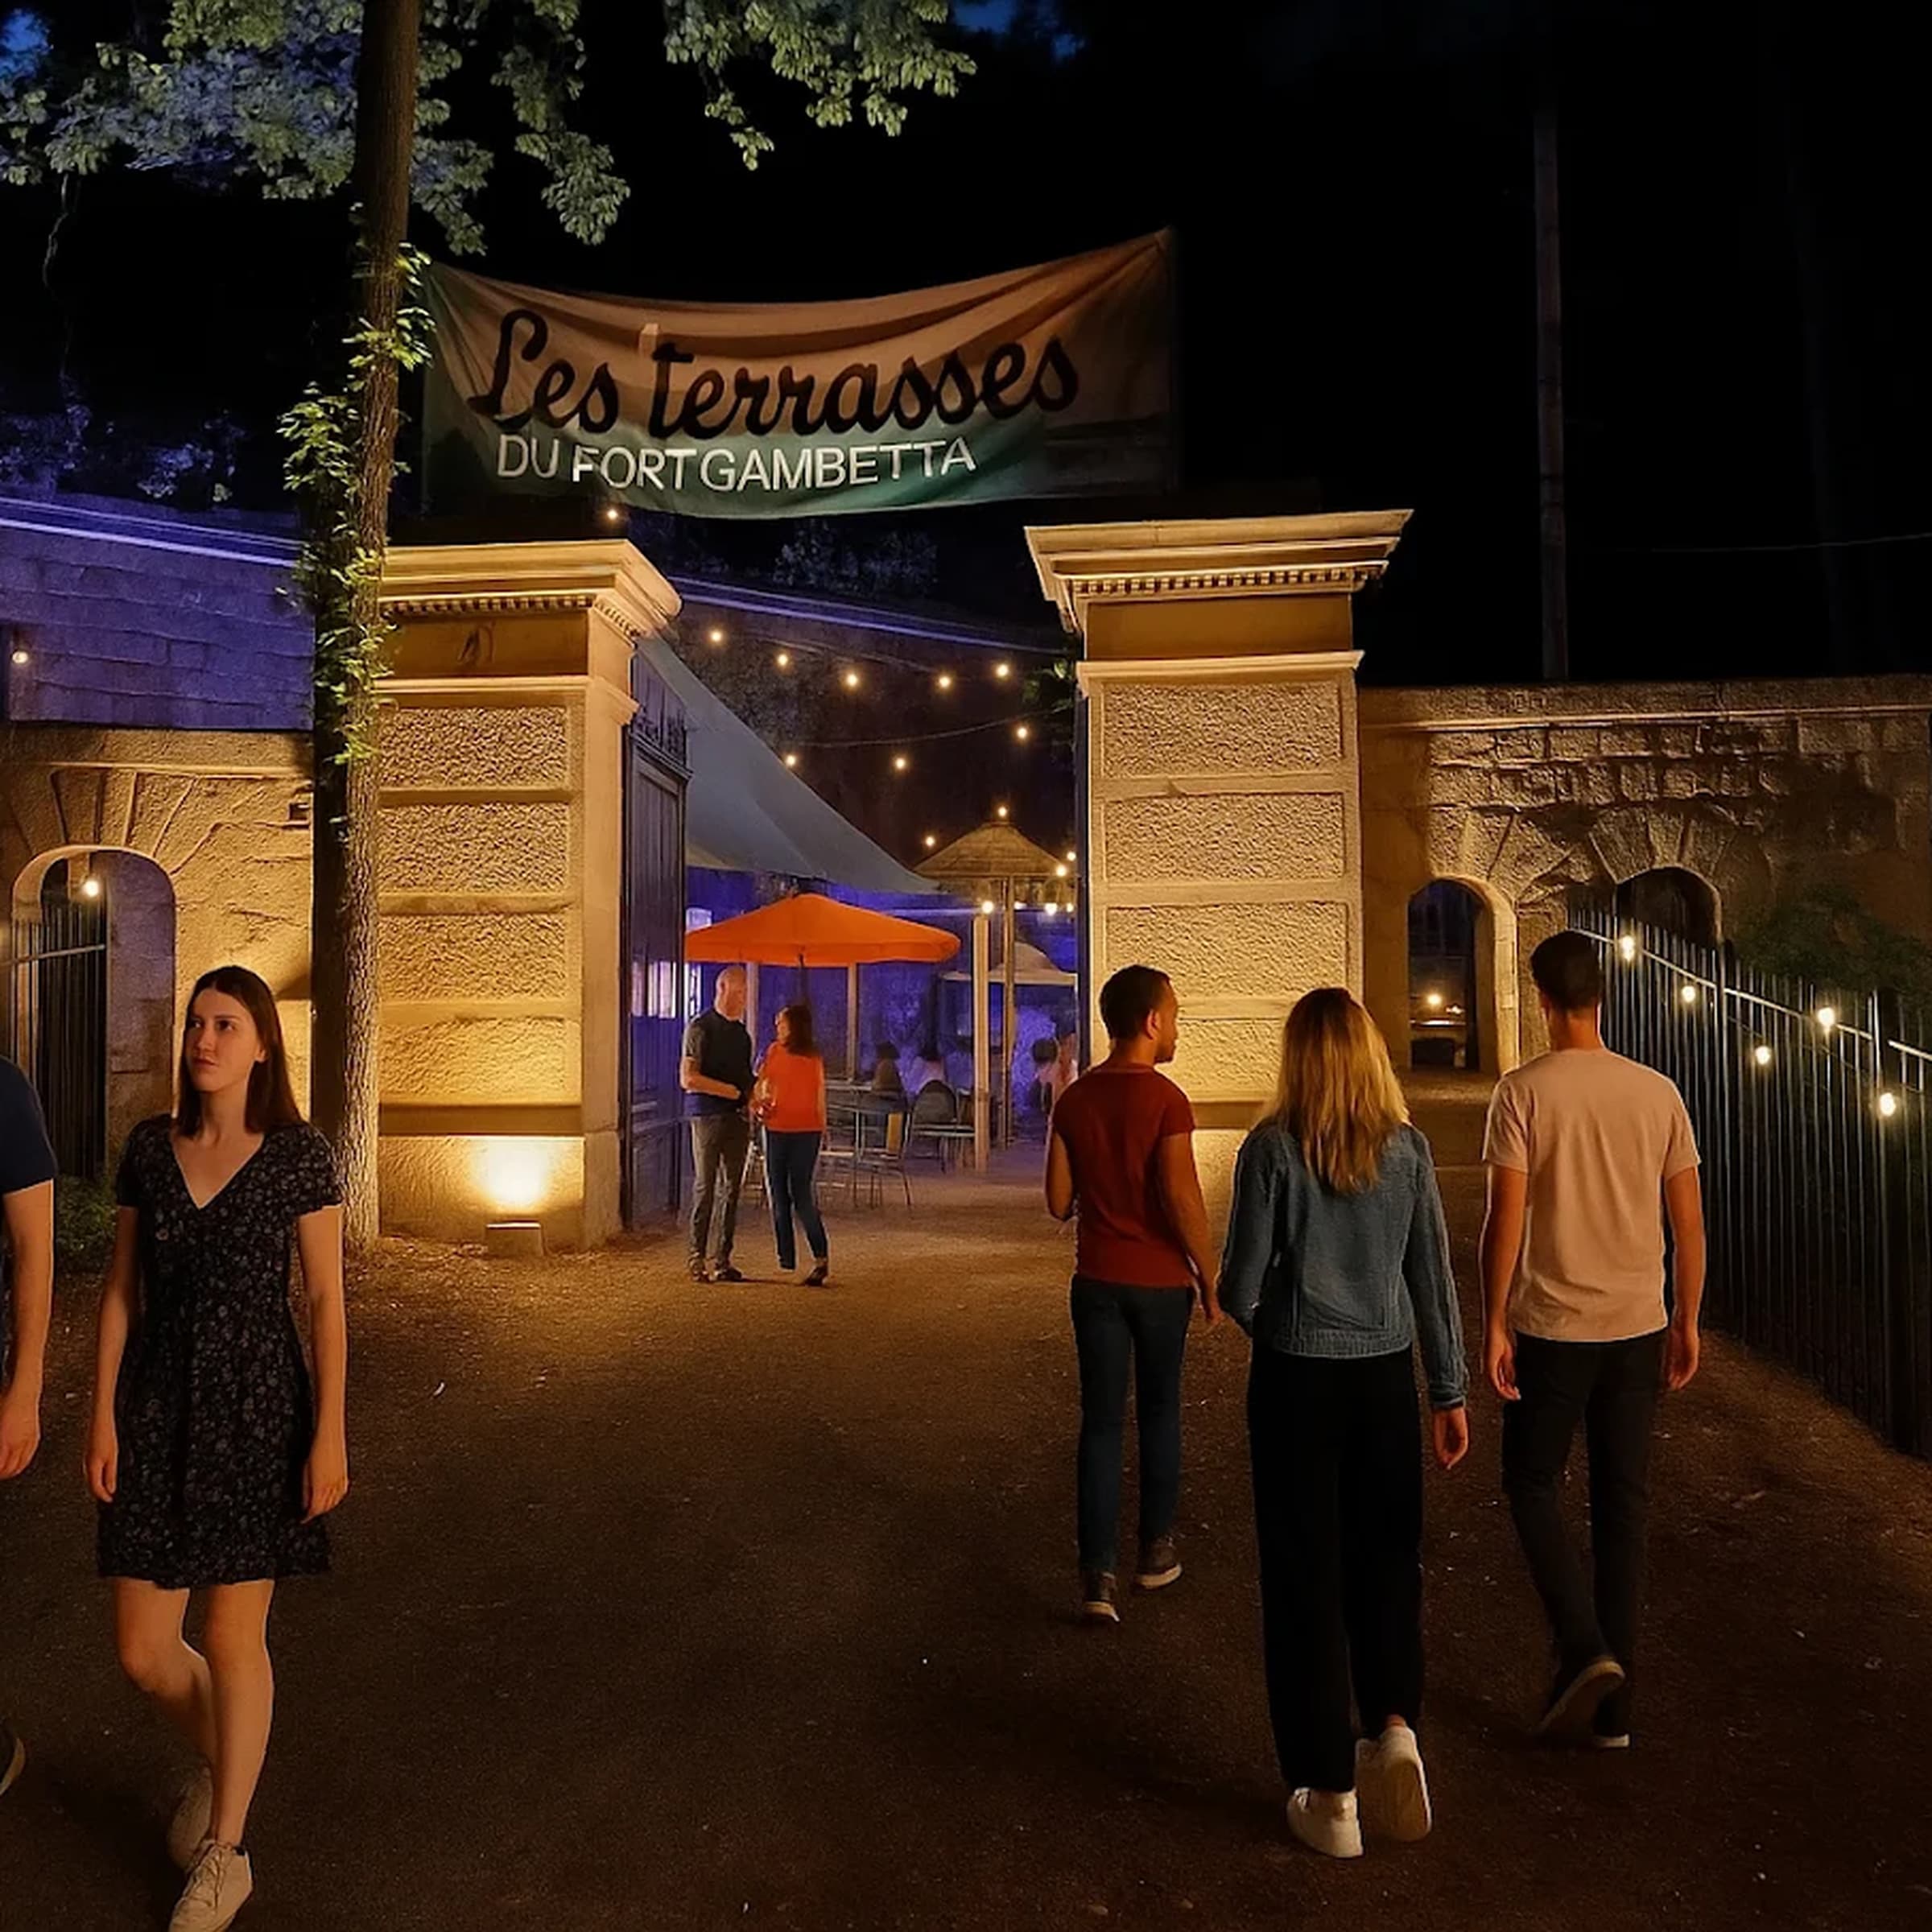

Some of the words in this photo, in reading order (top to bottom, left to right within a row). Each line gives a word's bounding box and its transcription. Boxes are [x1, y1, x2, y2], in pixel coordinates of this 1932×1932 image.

[468, 309, 618, 434] Les
[497, 435, 559, 479] DU
[572, 444, 696, 490] FORT
[699, 437, 977, 491] GAMBETTA
